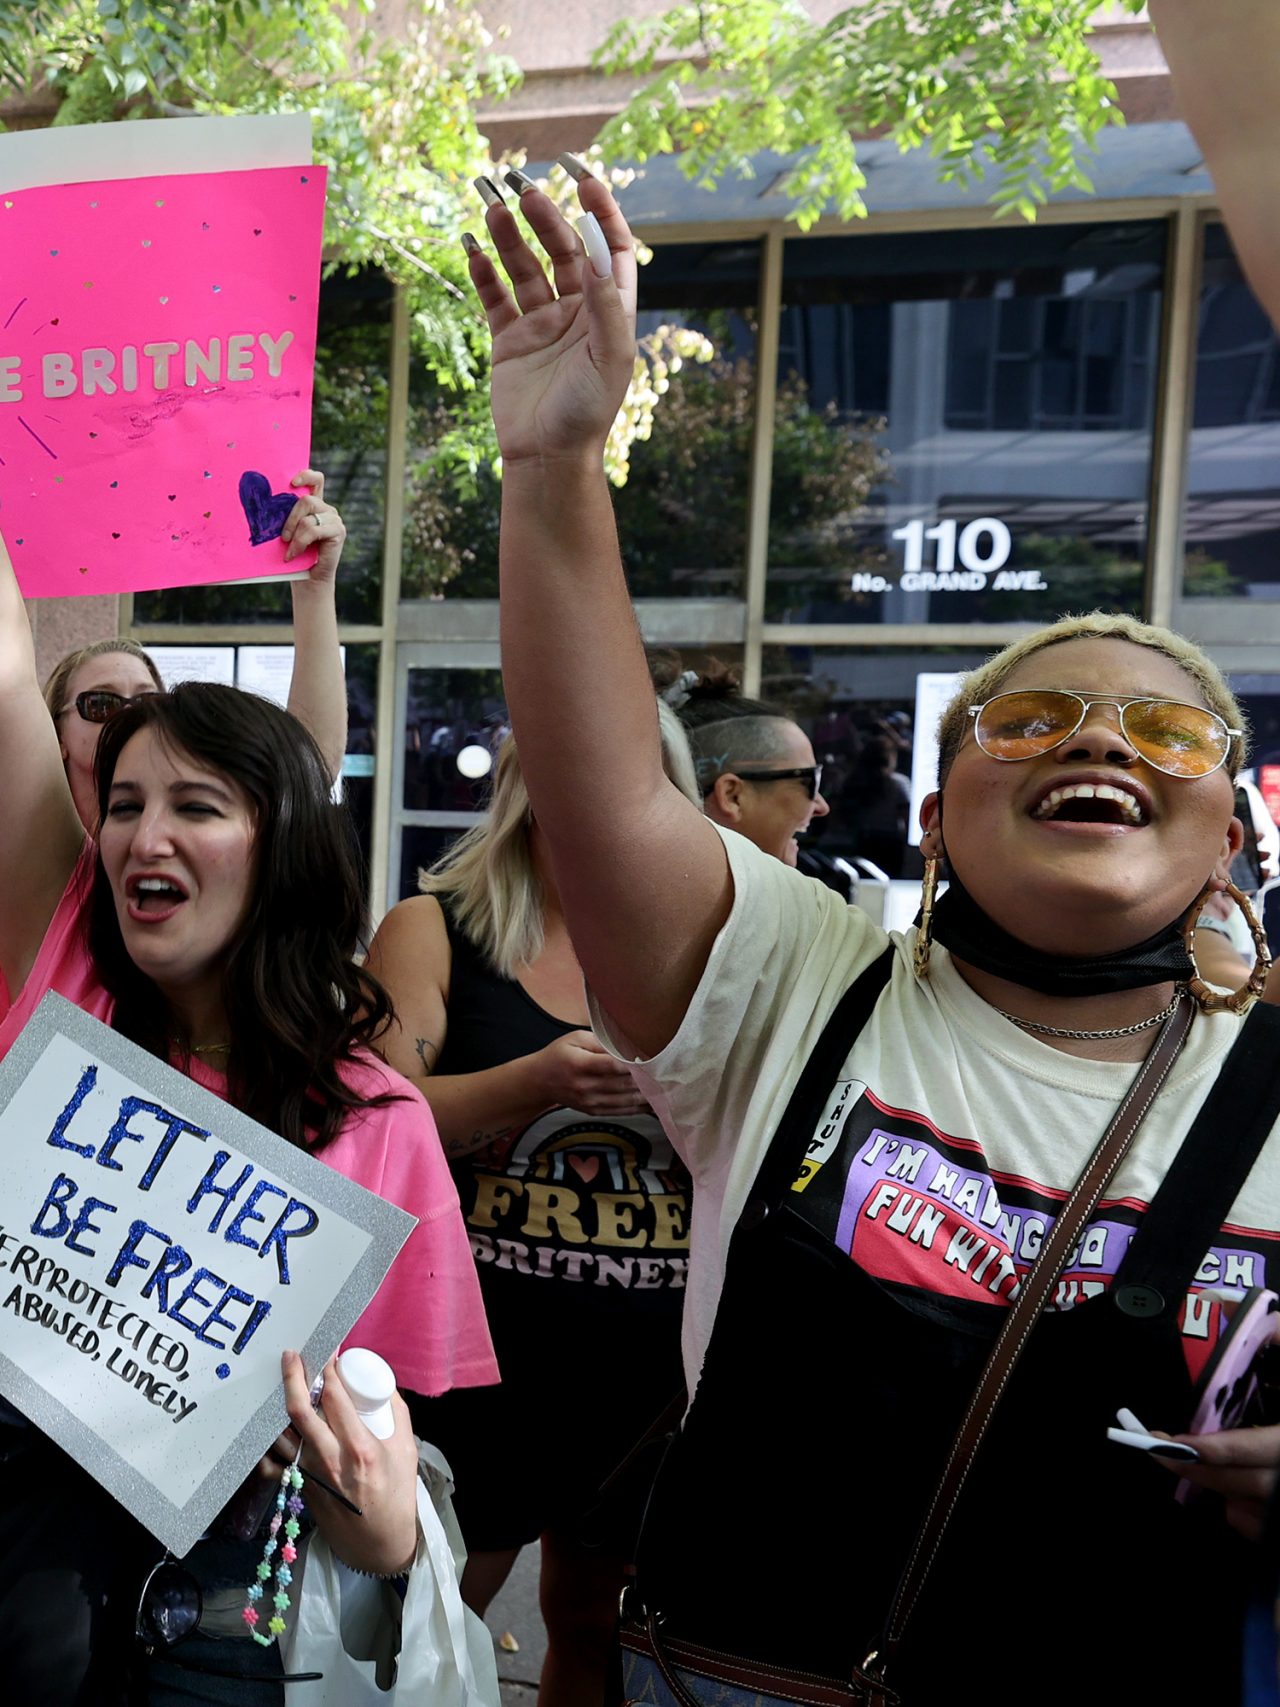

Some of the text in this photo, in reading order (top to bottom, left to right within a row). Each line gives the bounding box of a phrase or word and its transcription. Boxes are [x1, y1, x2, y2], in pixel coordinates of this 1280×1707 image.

[42, 331, 294, 399] BRITNEY
[892, 517, 1012, 573] 110
[851, 569, 1048, 593] No. GRAND AVE.
[46, 1063, 319, 1286] LET HER
[861, 1134, 930, 1184] I'M
[467, 1173, 691, 1250] FREE
[864, 1183, 947, 1250] FUN
[29, 1172, 273, 1381] BE FREE!
[2, 1284, 102, 1362] ABUSED,
